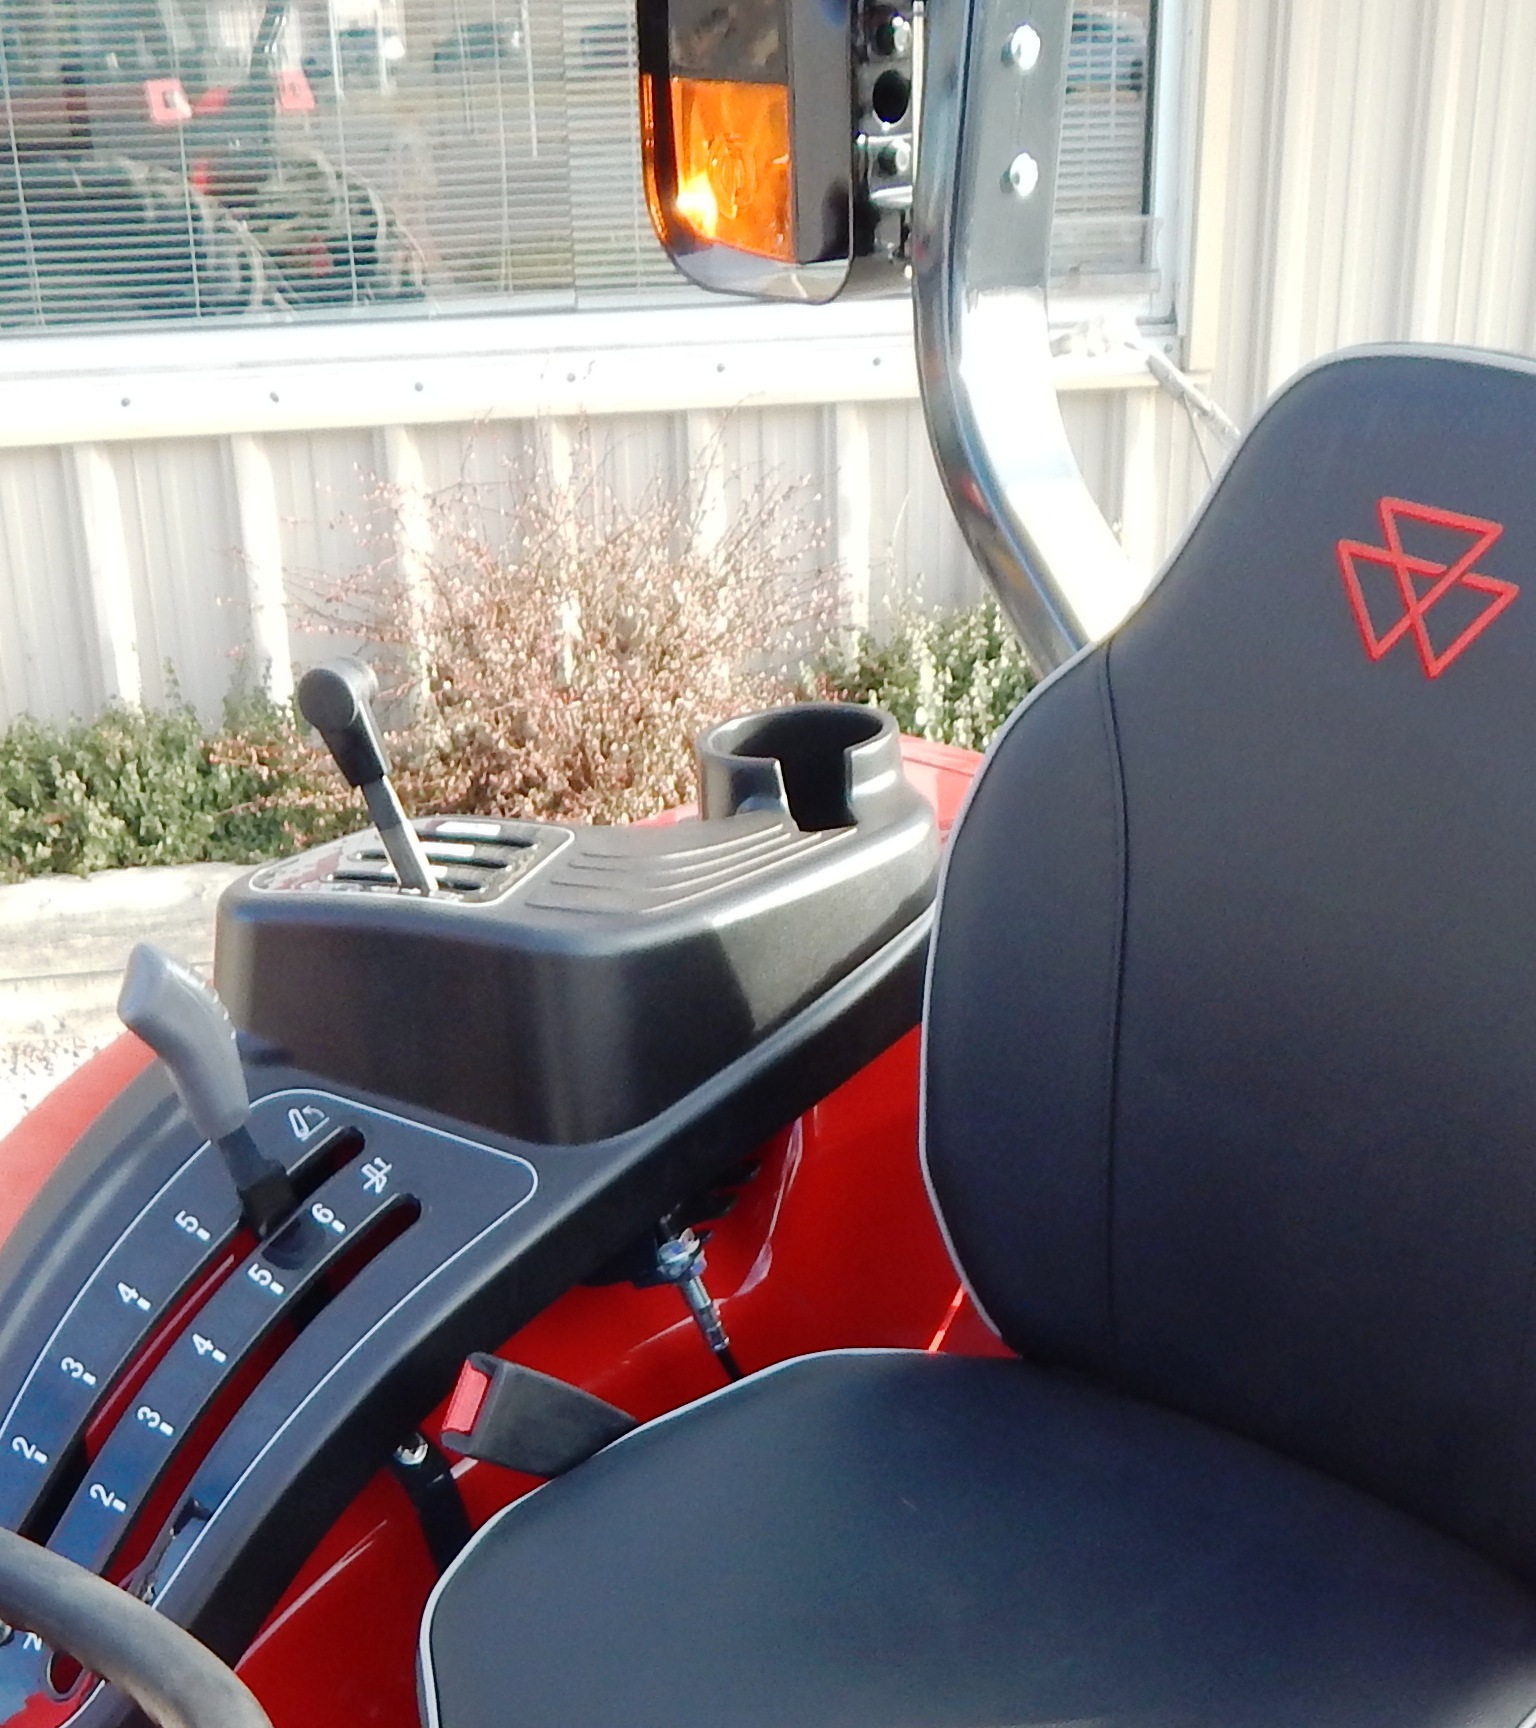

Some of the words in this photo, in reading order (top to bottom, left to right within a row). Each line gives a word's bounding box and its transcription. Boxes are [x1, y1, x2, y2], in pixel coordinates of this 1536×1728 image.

[174, 1209, 200, 1233] 5
[310, 1202, 335, 1224] 6
[246, 1263, 273, 1286] 5
[117, 1281, 139, 1303] 4
[192, 1333, 214, 1356] 4
[60, 1356, 84, 1378] 3
[137, 1405, 161, 1428] 3
[11, 1436, 36, 1459] 2
[89, 1483, 115, 1507] 2
